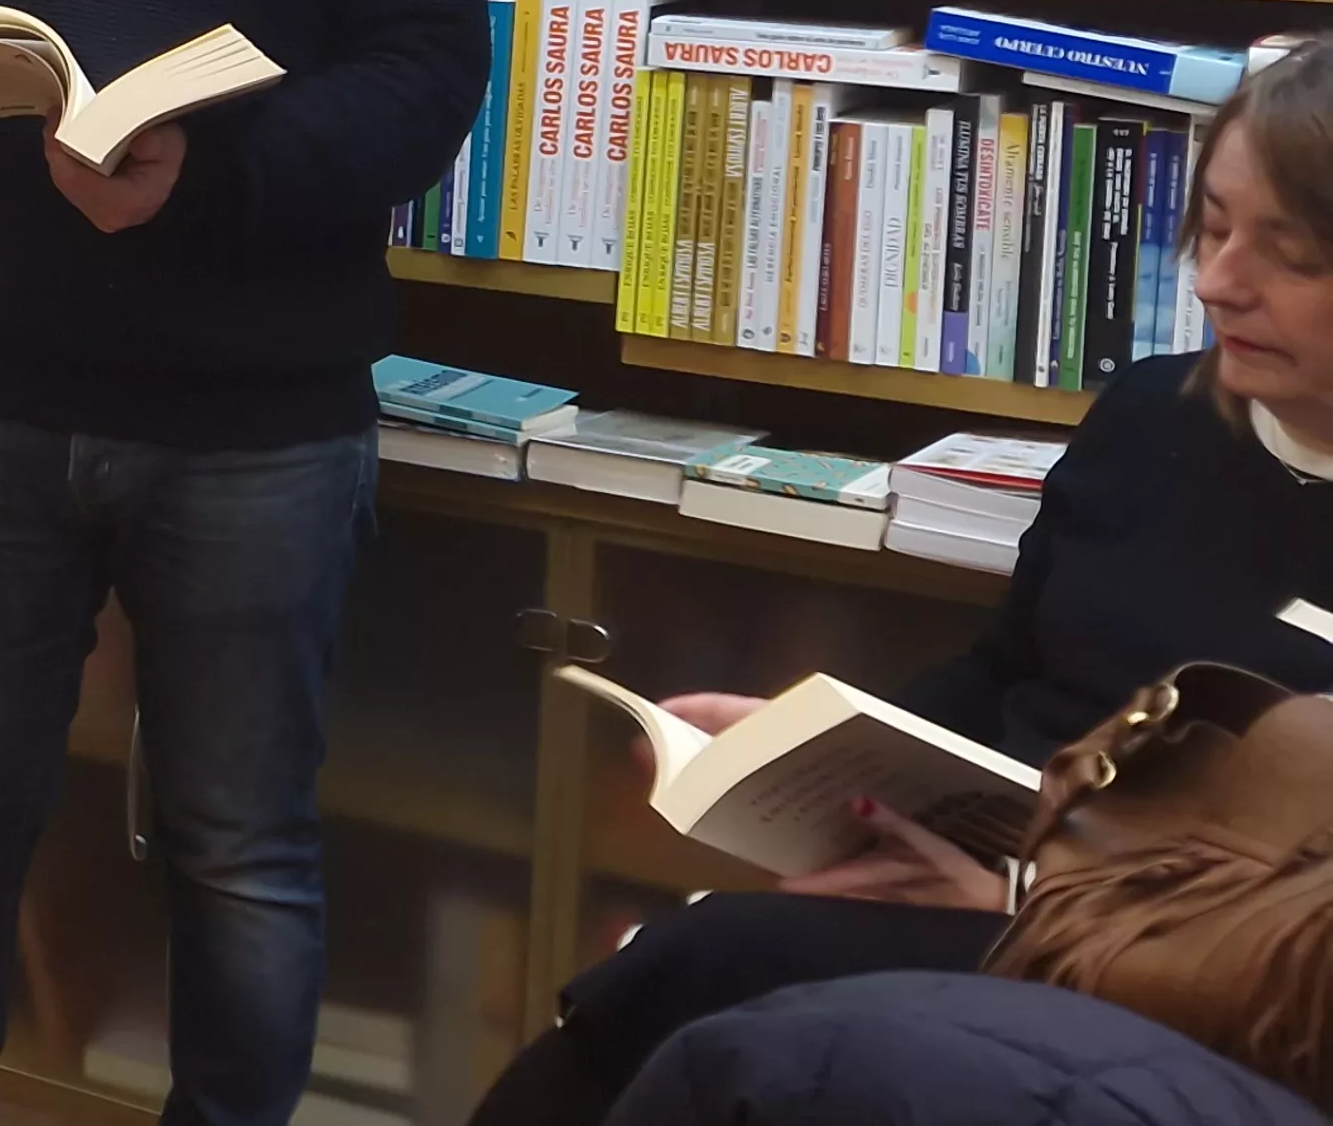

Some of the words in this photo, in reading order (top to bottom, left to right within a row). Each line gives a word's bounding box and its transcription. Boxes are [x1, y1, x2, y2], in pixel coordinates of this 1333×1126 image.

[544, 4, 571, 74] SAURA
[579, 7, 606, 77] SAURA
[613, 9, 640, 79] SAURA
[664, 40, 738, 69] SAURA
[743, 48, 833, 74] CARLOS
[994, 35, 1065, 59] CUERPO
[1066, 49, 1150, 76] NUESTRO
[538, 78, 564, 156] CARLOS
[572, 80, 599, 159] CARLOS
[606, 82, 632, 162] CARLOS
[955, 119, 971, 171] ILUMINA
